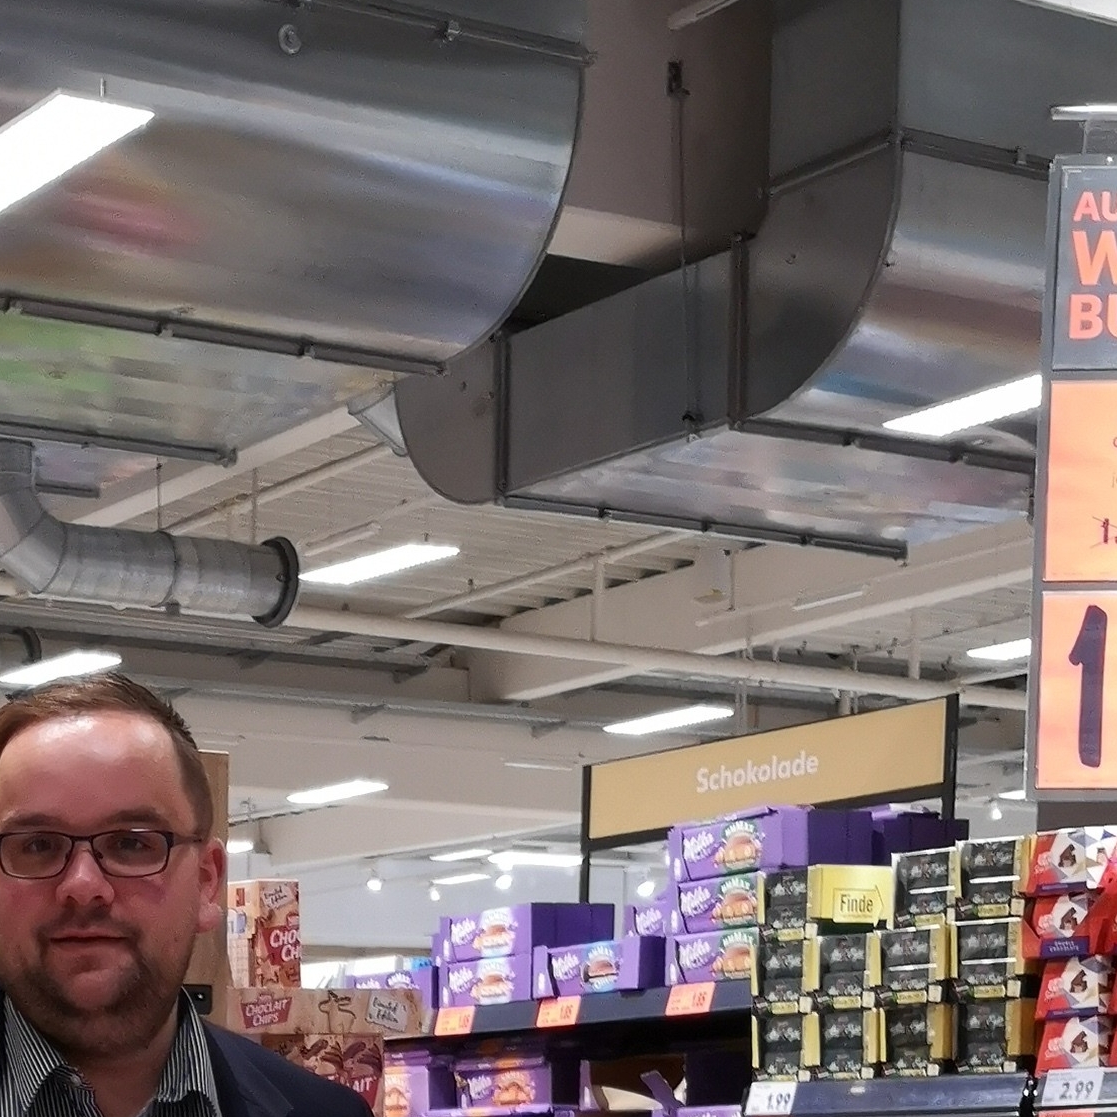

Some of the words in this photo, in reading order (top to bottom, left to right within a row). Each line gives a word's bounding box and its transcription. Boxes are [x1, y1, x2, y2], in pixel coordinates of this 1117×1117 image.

[696, 750, 820, 793] Schokolade
[840, 894, 873, 913] Finde
[1060, 1080, 1095, 1102] 2.99
